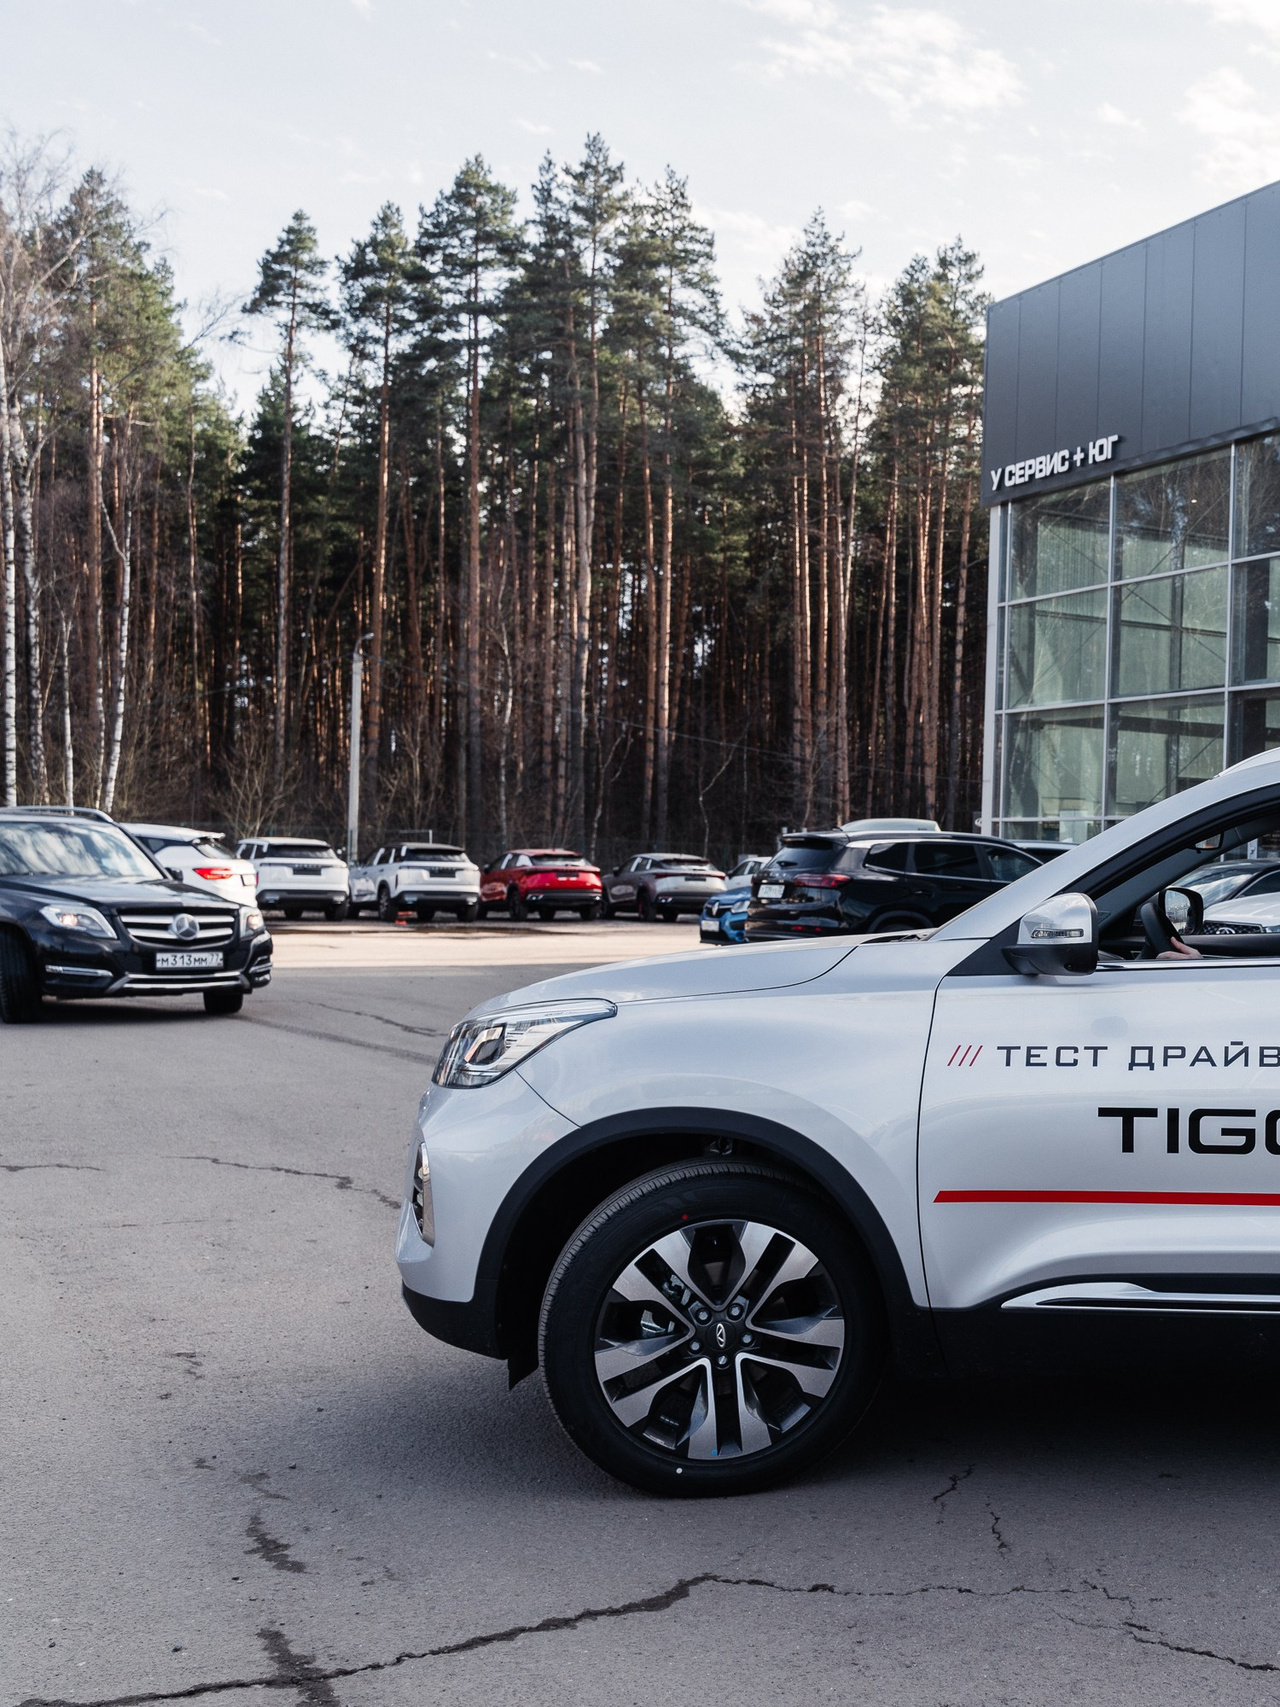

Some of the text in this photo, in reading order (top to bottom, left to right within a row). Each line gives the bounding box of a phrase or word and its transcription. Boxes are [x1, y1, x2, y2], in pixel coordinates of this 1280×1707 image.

[990, 467, 1002, 491] У
[1004, 449, 1070, 487] СЕРВИС
[1088, 434, 1118, 464] ЮГ
[997, 1045, 1108, 1067] ТЕСТ
